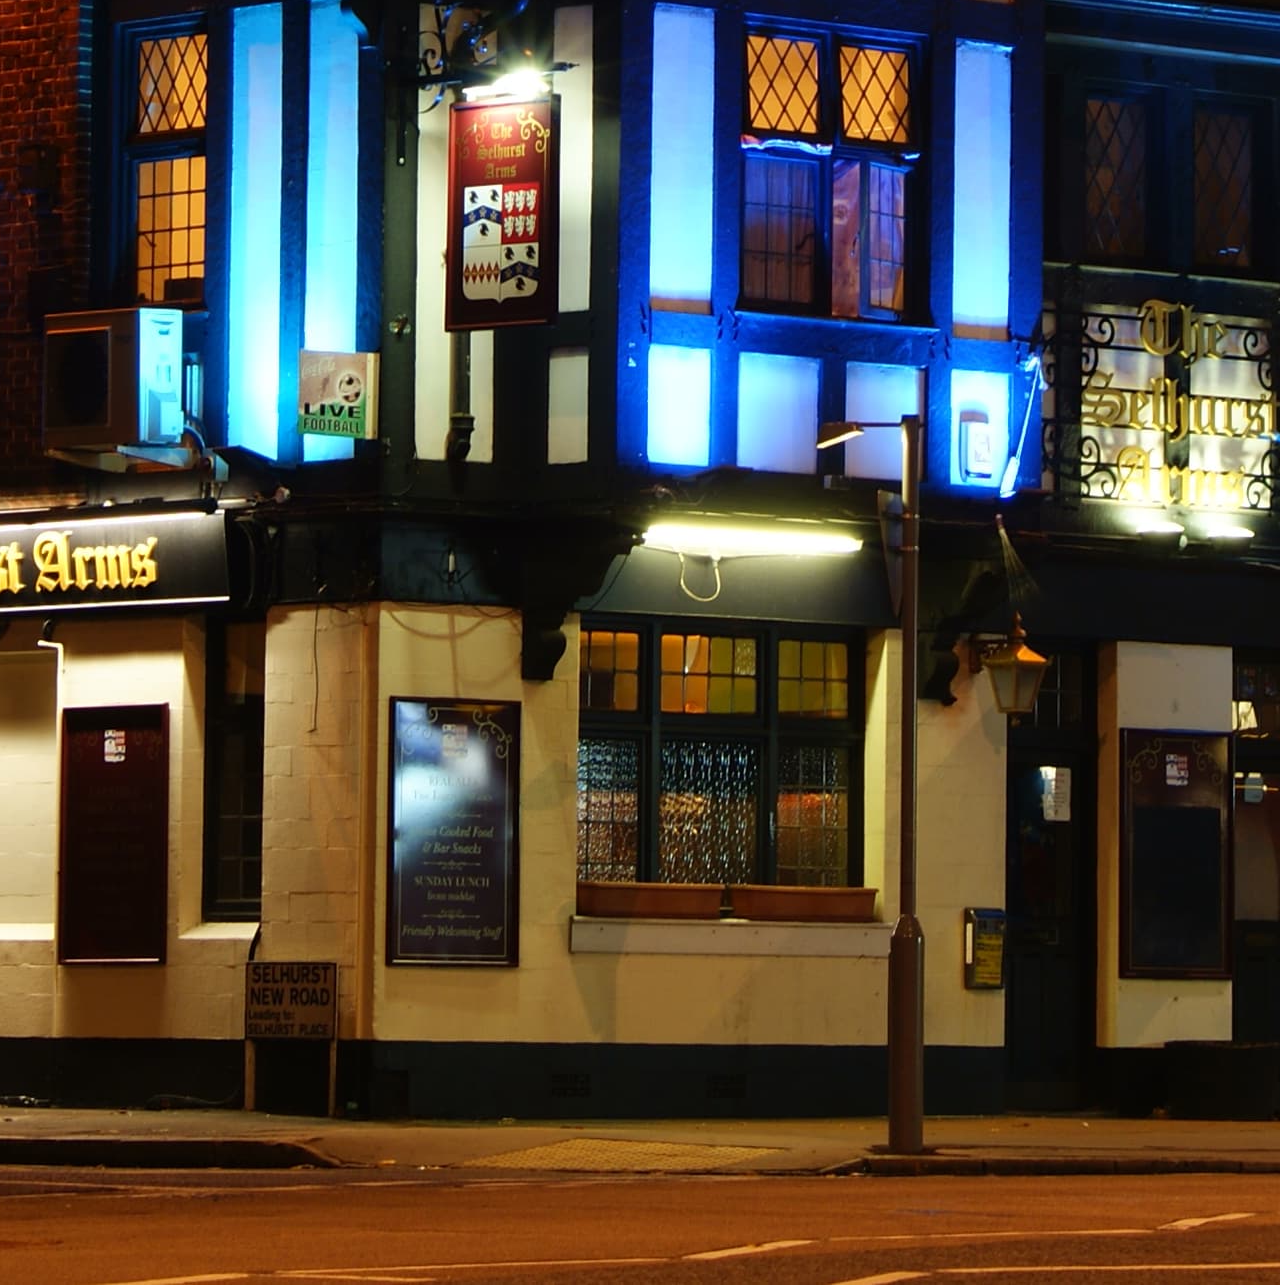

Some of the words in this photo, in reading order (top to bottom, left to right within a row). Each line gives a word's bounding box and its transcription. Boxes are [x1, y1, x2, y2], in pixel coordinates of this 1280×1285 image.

[490, 122, 513, 141] The
[477, 143, 526, 161] Selhurst
[485, 163, 517, 179] Arms
[1139, 299, 1227, 369] The
[304, 403, 361, 419] LIVE
[303, 418, 361, 434] FOOTBALL
[1116, 445, 1245, 510] Arms
[32, 529, 159, 594] Arms
[414, 875, 453, 888] SUNDAY
[455, 875, 490, 888] LUNCH
[252, 965, 330, 984] SELHURST
[250, 987, 284, 1006] NEW
[290, 987, 330, 1006] ROAD
